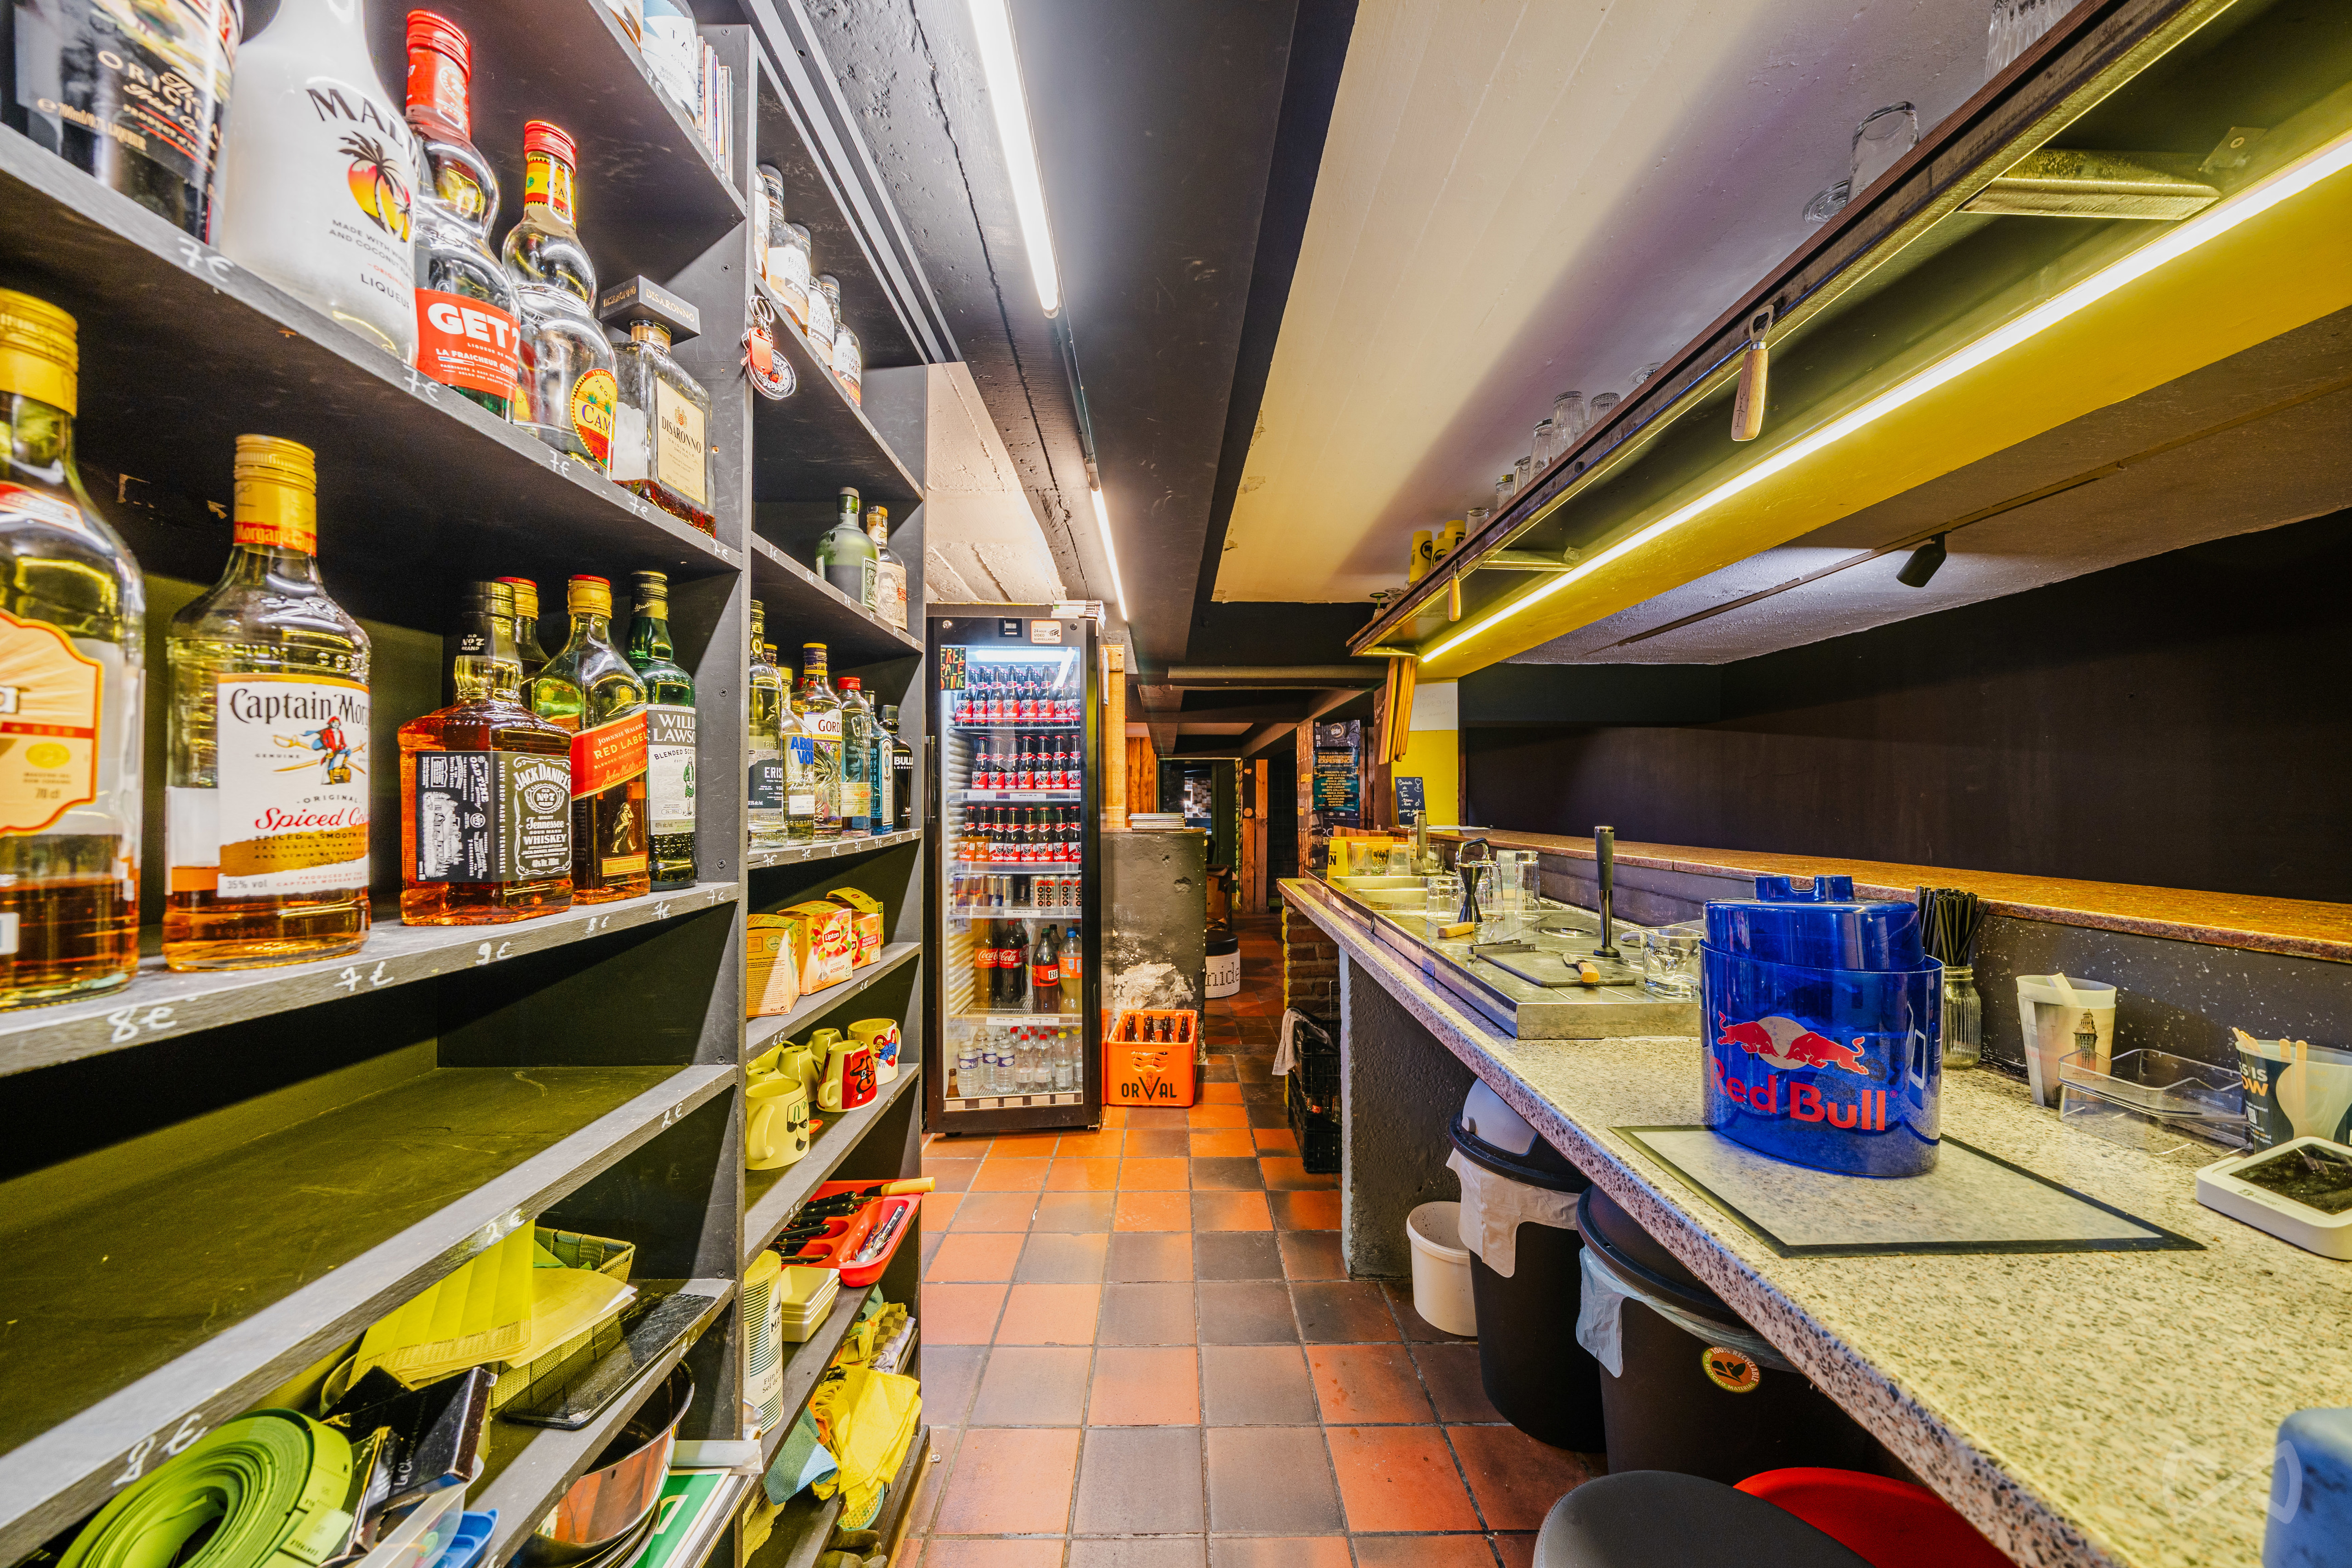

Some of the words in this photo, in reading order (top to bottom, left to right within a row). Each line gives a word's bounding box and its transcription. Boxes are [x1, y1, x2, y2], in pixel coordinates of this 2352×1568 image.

[332, 219, 363, 237] MADE
[366, 233, 390, 252] WITH
[329, 229, 352, 242] AND
[356, 239, 399, 268] COCONUT
[646, 289, 695, 322] DISARONNO
[427, 303, 509, 348] GET
[467, 343, 495, 354] LIQUEUR
[451, 350, 498, 367] FRAICHEUR
[662, 416, 701, 453] DISARONNO
[668, 437, 695, 458] ORIGINALE
[941, 648, 965, 664] FREE
[941, 663, 964, 676] PALE
[941, 675, 965, 689] STINE
[229, 689, 331, 724] Captain
[593, 745, 618, 759] RED
[620, 731, 647, 750] LABEL
[598, 731, 624, 746] JOHNNIE
[654, 749, 683, 760] BLENDED
[594, 758, 617, 769] BLENDED
[513, 766, 537, 791] JACK
[538, 763, 571, 793] DANIEL'S
[476, 776, 489, 802] TIME
[255, 807, 345, 831] Spiced
[526, 817, 565, 830] Tennessee
[522, 834, 567, 845] WHISKEY
[226, 881, 248, 889] 35%
[825, 932, 839, 940] Lipton
[831, 965, 844, 974] ROSEHIP
[1121, 1076, 1177, 1101] ORVAL
[1709, 1054, 1777, 1114] Red
[1790, 1081, 1886, 1131] Bull
[498, 1321, 518, 1330] 096531
[1705, 1364, 1725, 1386] RECYCLED
[1732, 1351, 1759, 1382] RECYCLABLE
[764, 1373, 775, 1384] Fijn
[763, 1383, 771, 1393] Sel
